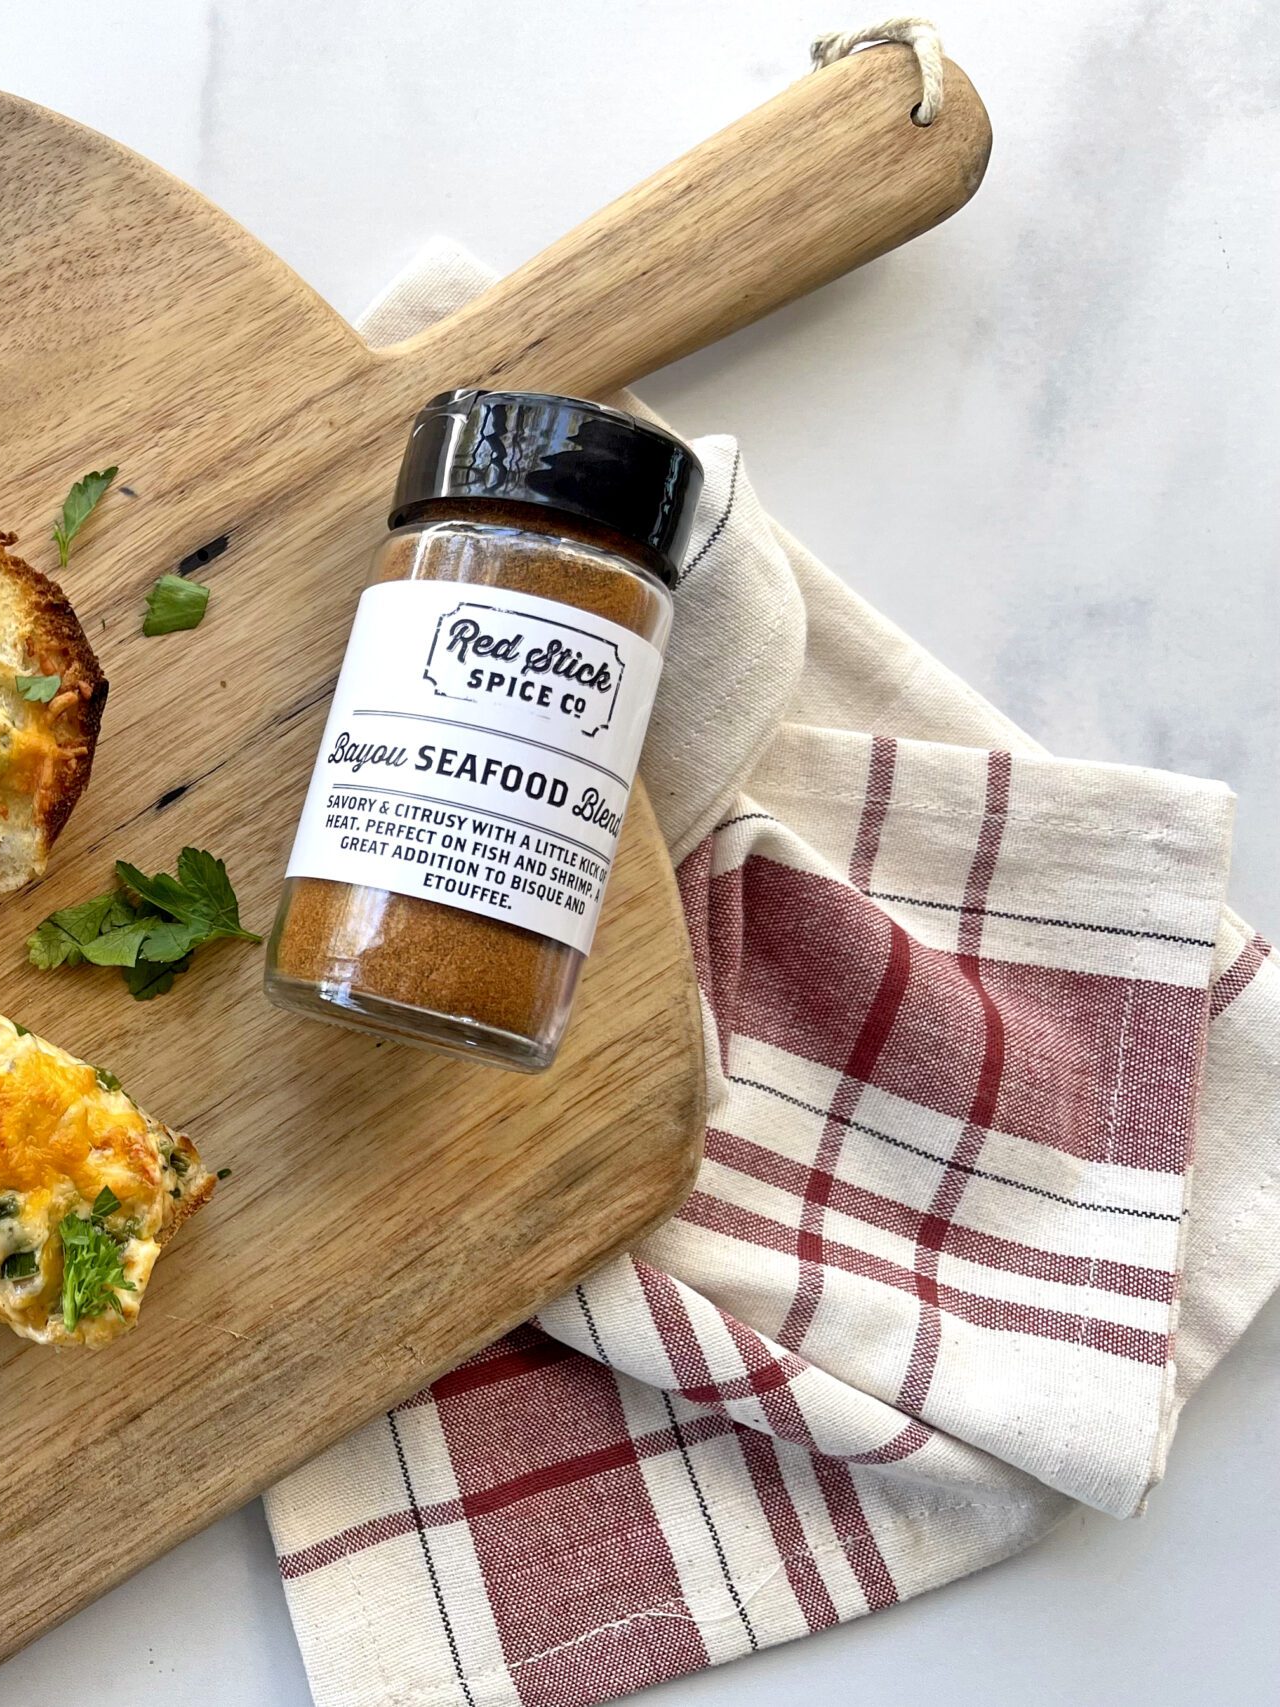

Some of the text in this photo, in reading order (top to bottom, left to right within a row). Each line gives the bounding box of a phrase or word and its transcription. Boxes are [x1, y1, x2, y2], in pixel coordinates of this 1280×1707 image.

[446, 618, 613, 695] Red Stick
[466, 668, 554, 708] SPICE
[327, 731, 409, 773] Bayou
[414, 745, 569, 809] SEAFOOD
[325, 813, 601, 904] HEAT. PERFECT ON FISH AND SHRIMP. A
[326, 794, 378, 813] SAVORY
[379, 800, 390, 815] &
[394, 803, 469, 831] CITRUSY
[472, 819, 517, 845] WITH
[519, 834, 531, 850] A
[534, 839, 579, 868] LITTLE
[579, 855, 601, 880] KICK
[340, 835, 586, 916] GREAT ADDITION TO BISQUE AND
[422, 872, 513, 910] ETOUFFEE.
